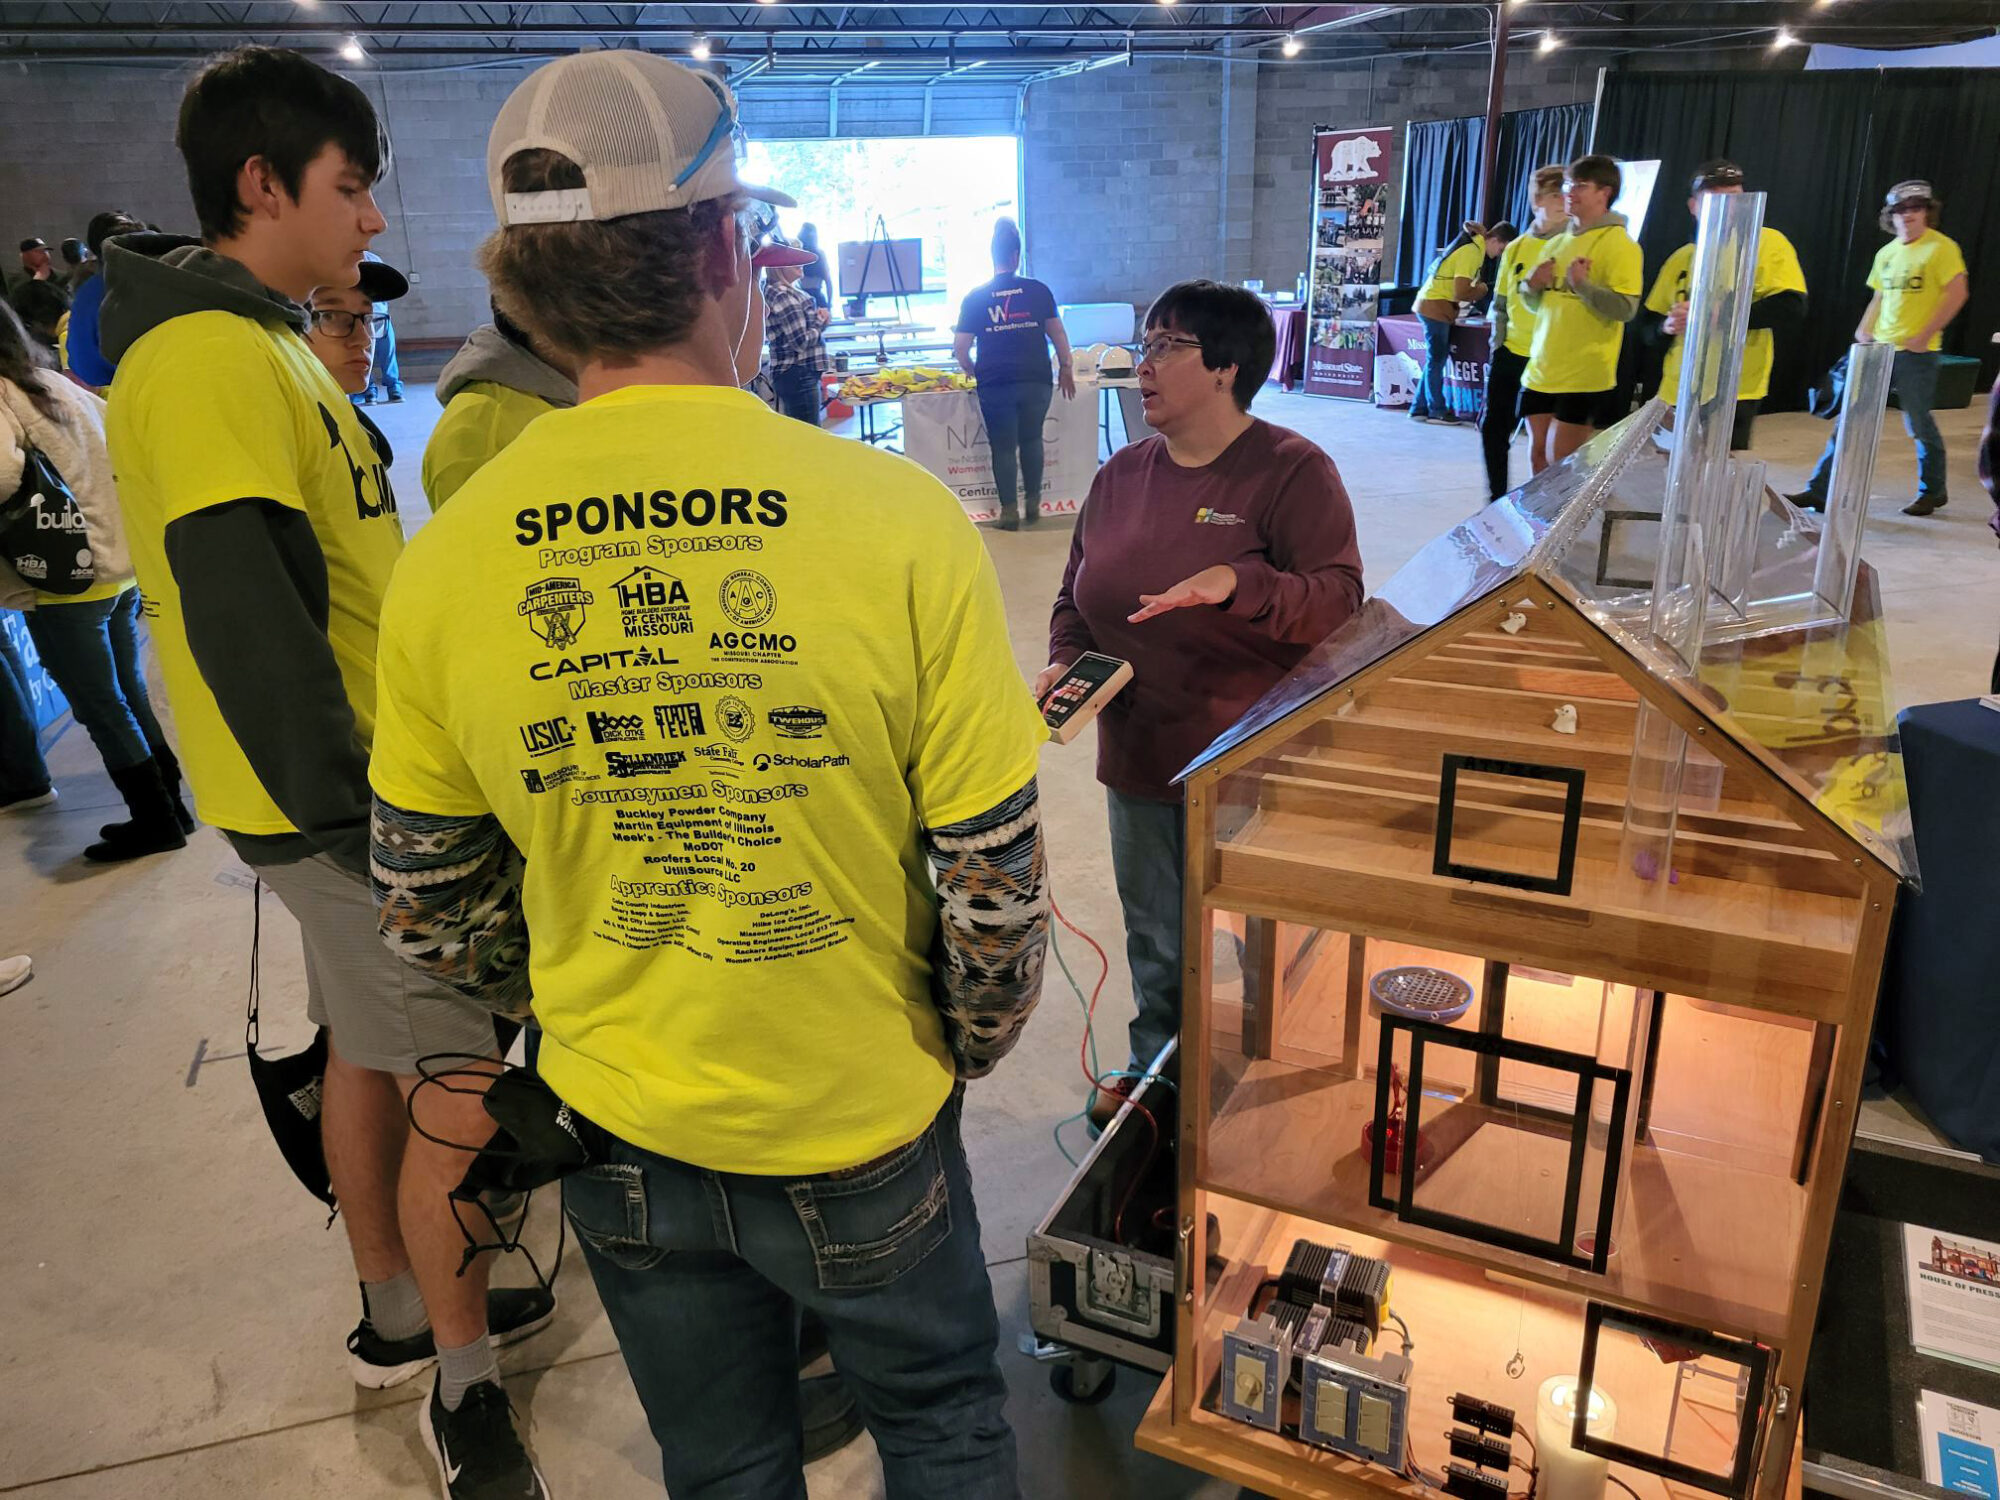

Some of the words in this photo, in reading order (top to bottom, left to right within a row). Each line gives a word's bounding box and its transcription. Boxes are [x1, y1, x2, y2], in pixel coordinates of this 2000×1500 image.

[996, 288, 1023, 297] support
[994, 321, 1039, 332] Construction
[947, 464, 986, 475] Women
[959, 484, 1000, 498] Centra
[515, 488, 788, 546] SPONSORS
[539, 541, 641, 568] Program
[647, 534, 763, 559] Sponsors
[528, 581, 577, 596] MID-AMERICA
[621, 581, 690, 608] HBA
[518, 591, 594, 617] CARPENTERS
[622, 616, 637, 626] OF
[641, 612, 692, 624] CENTRAL
[624, 622, 694, 638] MISSOURI
[709, 632, 797, 652] AGCMO
[568, 675, 651, 701] Master
[656, 672, 763, 694] Sponsors
[653, 702, 701, 722] STATE
[520, 716, 575, 752] USIC
[603, 730, 623, 738] DICK
[624, 729, 645, 737] OTKE
[656, 717, 707, 740] TECH
[694, 747, 720, 757] State
[722, 747, 738, 759] Fair
[773, 754, 850, 768] ScholarPath
[571, 782, 707, 806] Journeymen
[711, 780, 809, 804] Sponsors
[616, 809, 665, 820] Buckley
[669, 806, 716, 817] Powder
[719, 806, 766, 823] Company
[614, 821, 653, 831] Martin
[657, 819, 722, 832] Equipment
[725, 821, 732, 829] of
[734, 822, 775, 834] Illinois
[612, 832, 655, 843] Meek's
[665, 831, 691, 840] The
[693, 830, 735, 844] Builder's
[737, 836, 783, 847] Choice
[683, 842, 725, 852] MoDOT
[643, 854, 691, 864] Roofers
[695, 854, 724, 864] Local
[725, 857, 738, 871] No.
[740, 863, 756, 872] 20
[663, 866, 724, 878] UtiliSource
[724, 872, 742, 884] LLC
[610, 874, 716, 898] Apprentice
[717, 882, 813, 908] Sponsors
[625, 900, 649, 909] County
[630, 916, 643, 926] City
[788, 910, 820, 923] Company
[717, 938, 751, 947] Operating
[795, 929, 815, 939] Local
[829, 917, 855, 929] Training
[740, 929, 771, 938] Missouri
[773, 924, 803, 935] Welding
[804, 914, 831, 929] Institute
[725, 956, 752, 964] Women
[796, 943, 826, 956] Missouri
[827, 935, 848, 947] Branch
[768, 940, 808, 952] Equipment
[809, 930, 839, 944] Company
[1920, 1273, 1952, 1287] HOUSE
[1955, 1282, 1967, 1290] OF
